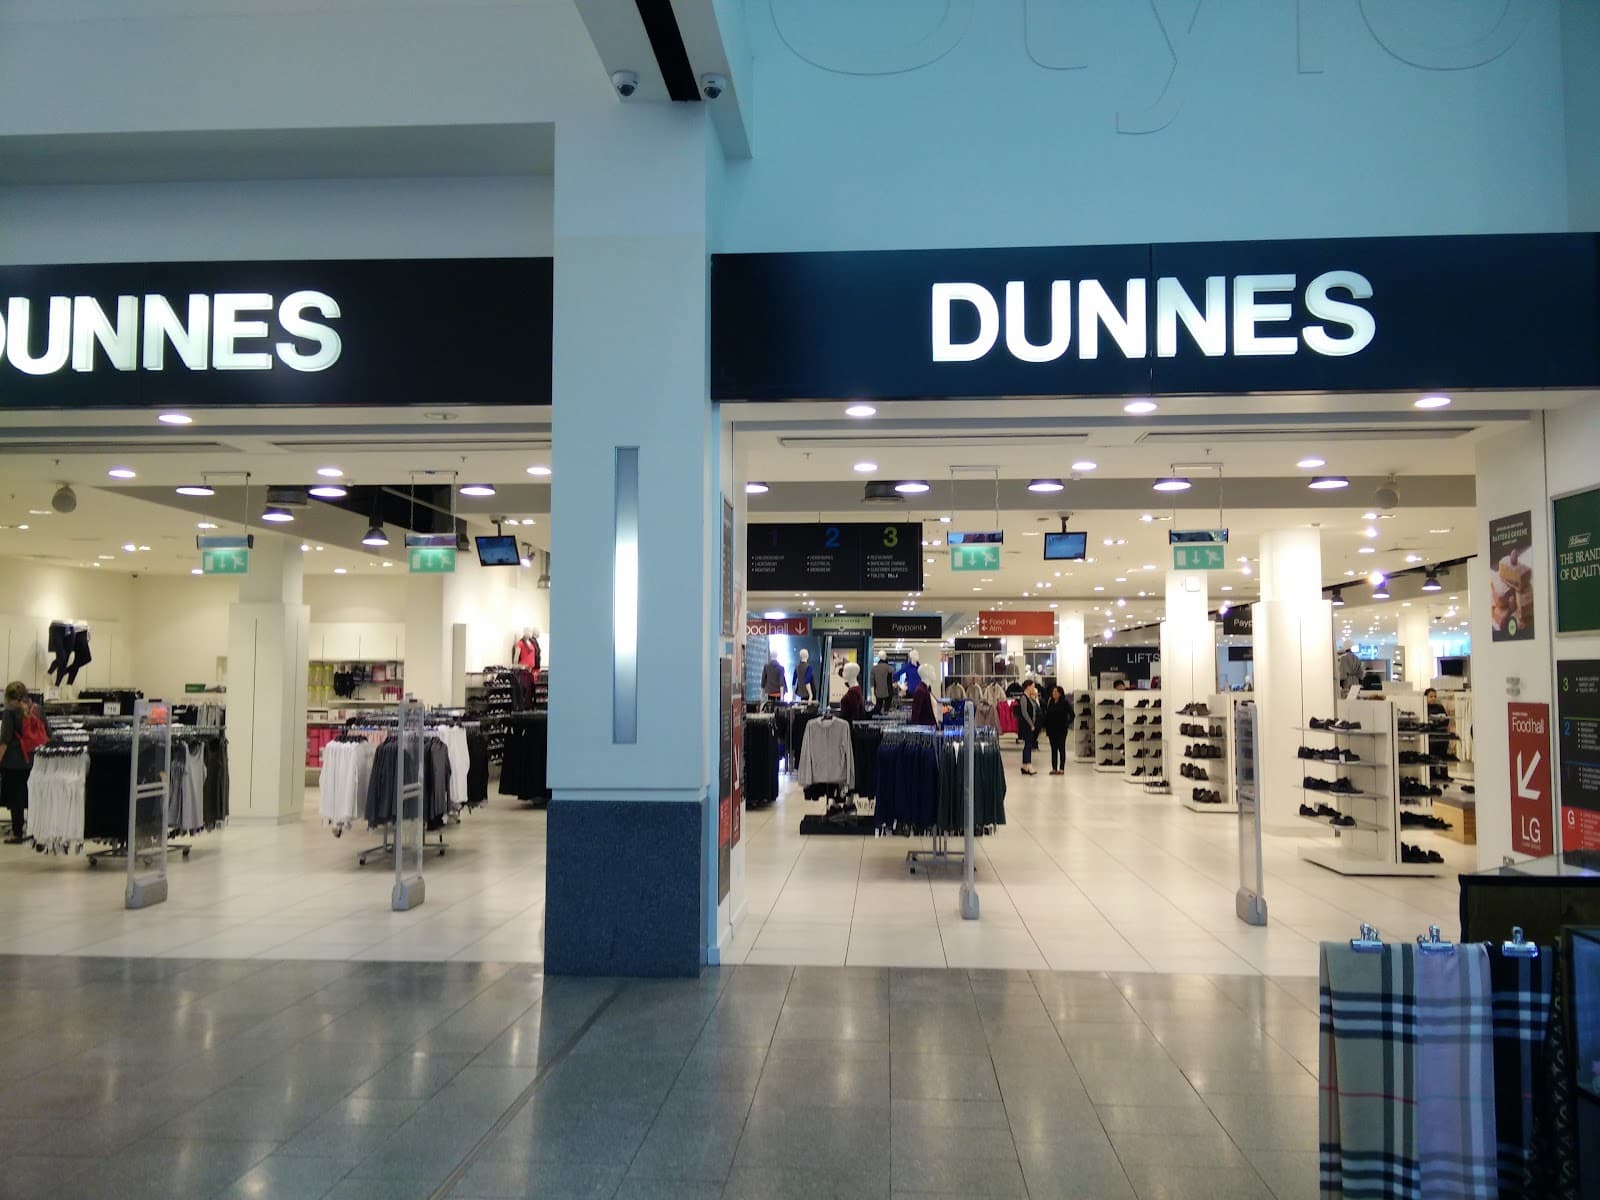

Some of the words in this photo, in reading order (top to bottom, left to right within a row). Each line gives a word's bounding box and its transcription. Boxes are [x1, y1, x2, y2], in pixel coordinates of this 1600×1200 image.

[932, 271, 1375, 362] DUNNES
[0, 291, 341, 375] UNNES
[825, 527, 840, 548] 2
[883, 527, 898, 547] 3
[1560, 553, 1574, 566] THE
[1560, 568, 1570, 581] OF
[746, 623, 767, 635] ood
[769, 623, 789, 635] hall
[892, 623, 922, 633] Paypoint
[1233, 618, 1253, 628] Payp
[1127, 652, 1160, 664] LIFTS
[1562, 676, 1569, 692] 3
[1564, 720, 1571, 736] 2
[1567, 810, 1575, 825] G
[1521, 815, 1540, 843] LG
